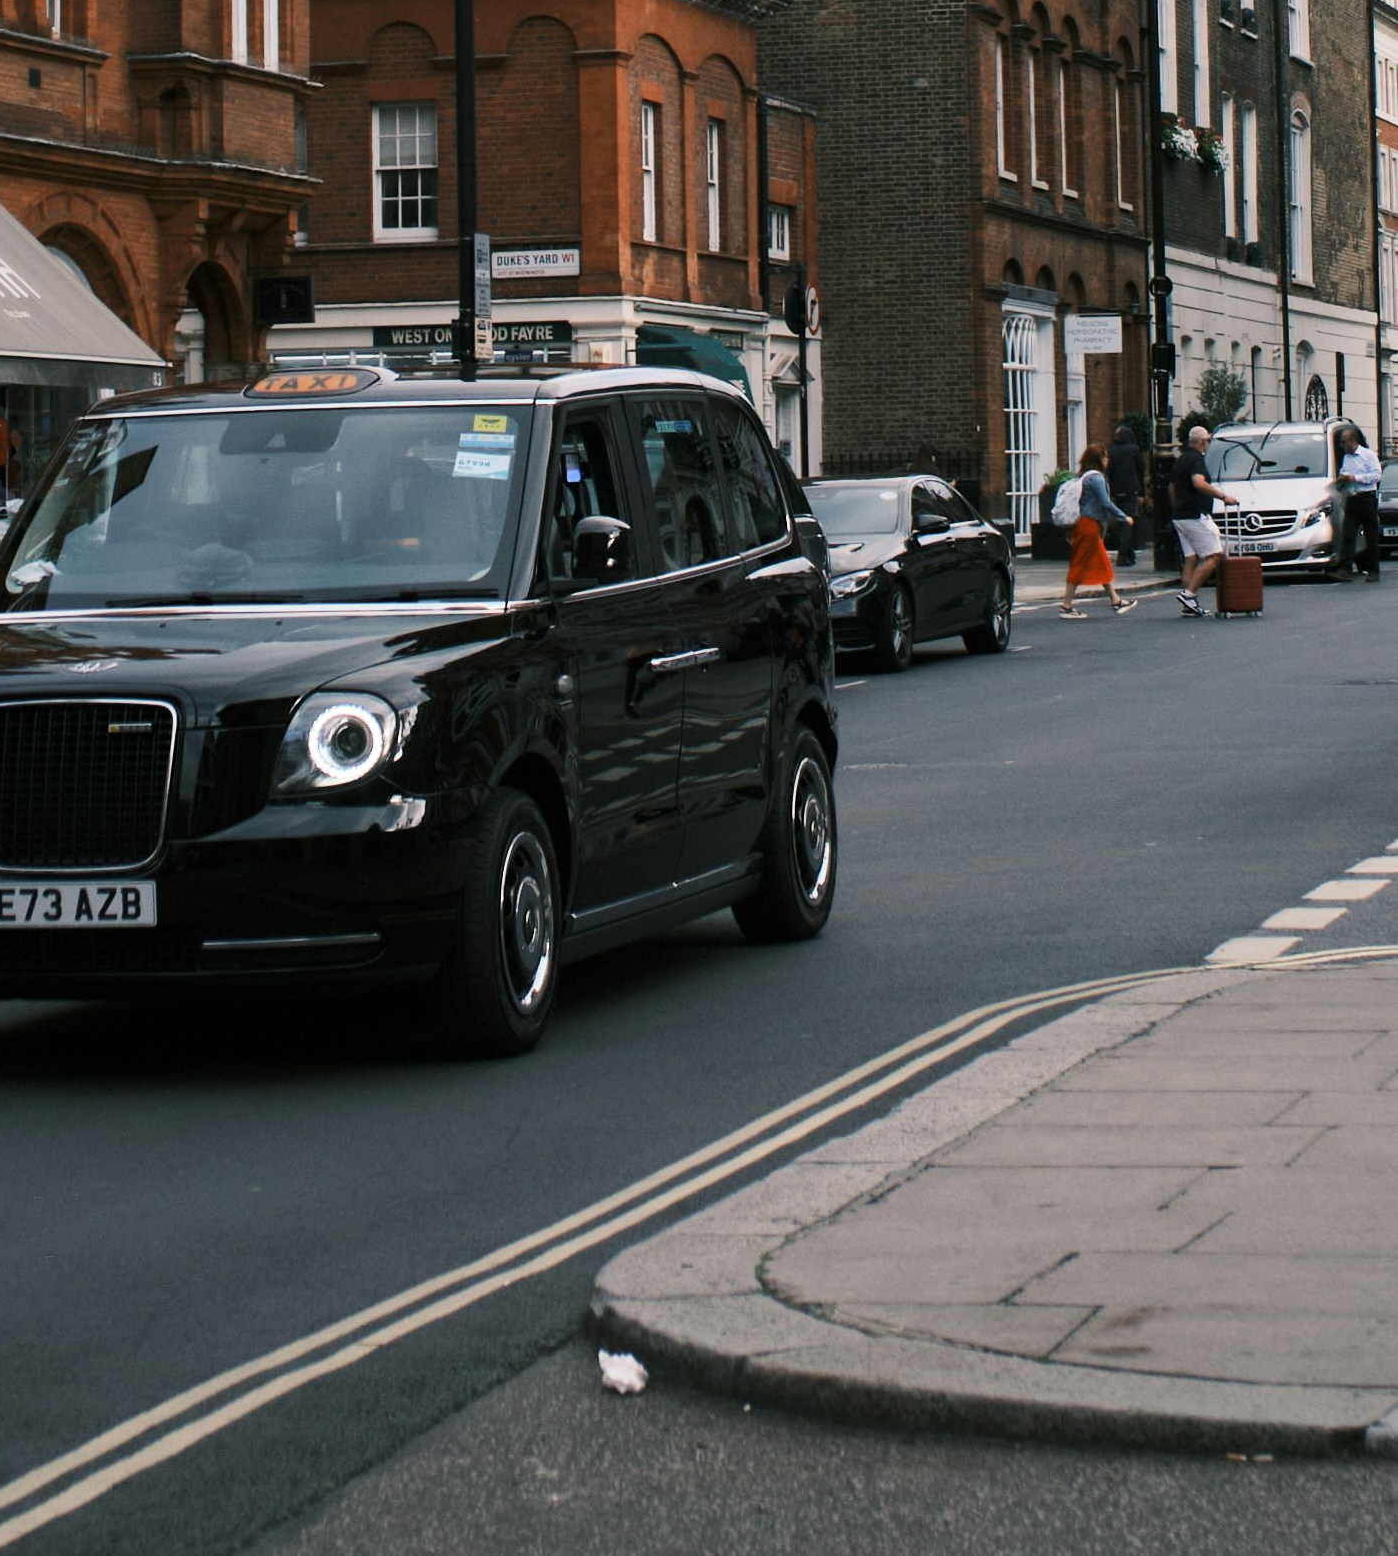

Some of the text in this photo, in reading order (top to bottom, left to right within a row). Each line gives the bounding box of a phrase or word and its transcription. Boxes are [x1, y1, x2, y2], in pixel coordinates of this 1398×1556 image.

[532, 253, 559, 265] YARD
[561, 253, 575, 264] W1
[390, 328, 431, 344] WEST
[434, 327, 452, 343] ON
[510, 325, 554, 342] FAYRE
[152, 372, 162, 387] 83
[264, 373, 348, 391] TAXI
[75, 887, 142, 921] AZB
